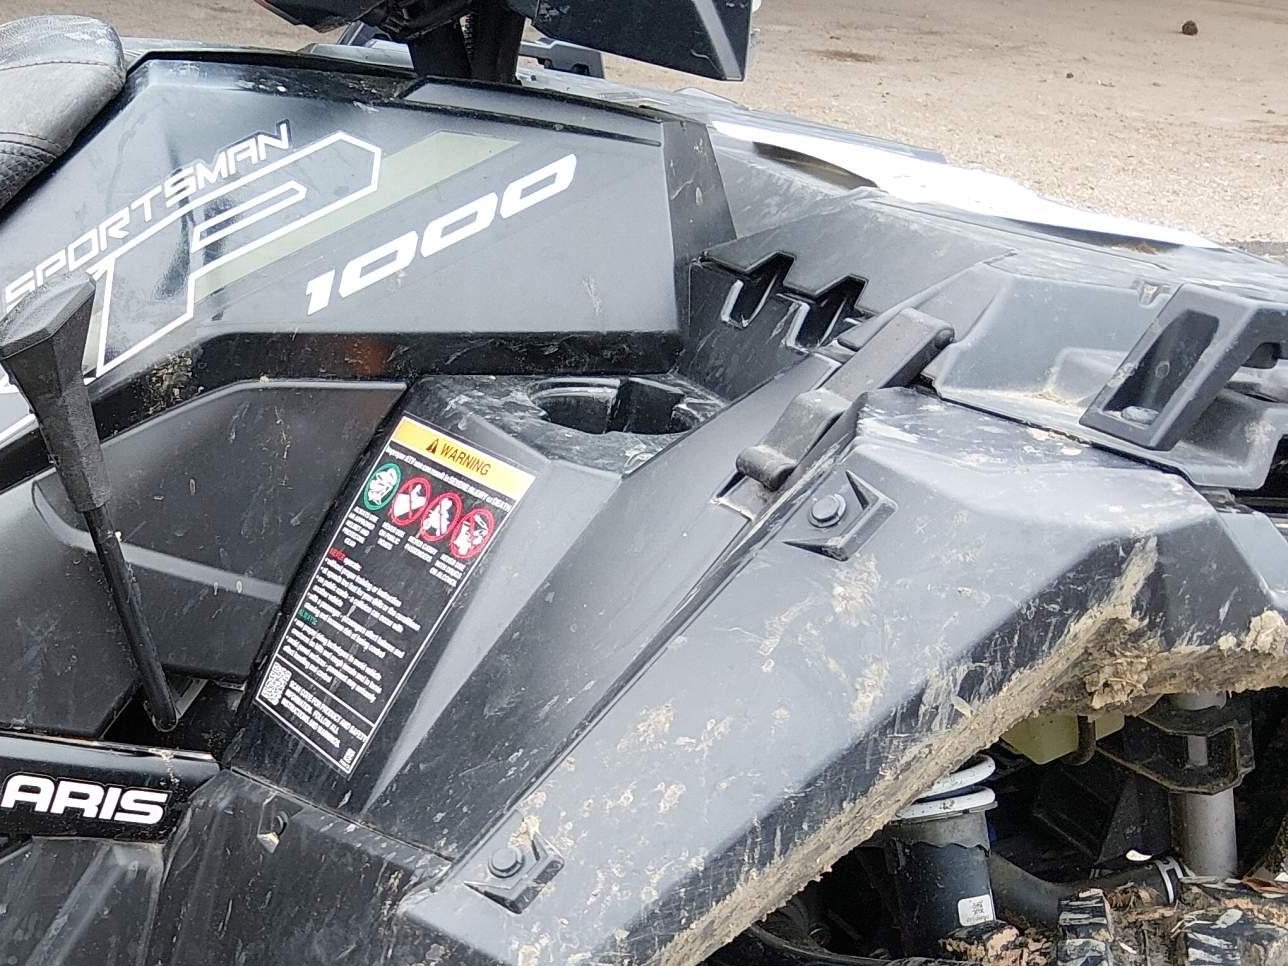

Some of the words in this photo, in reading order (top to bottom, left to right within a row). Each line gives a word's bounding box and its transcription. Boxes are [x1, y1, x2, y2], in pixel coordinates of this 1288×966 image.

[4, 122, 291, 314] SPORTSMAN
[306, 154, 577, 315] 1000
[440, 443, 491, 476] WARNING
